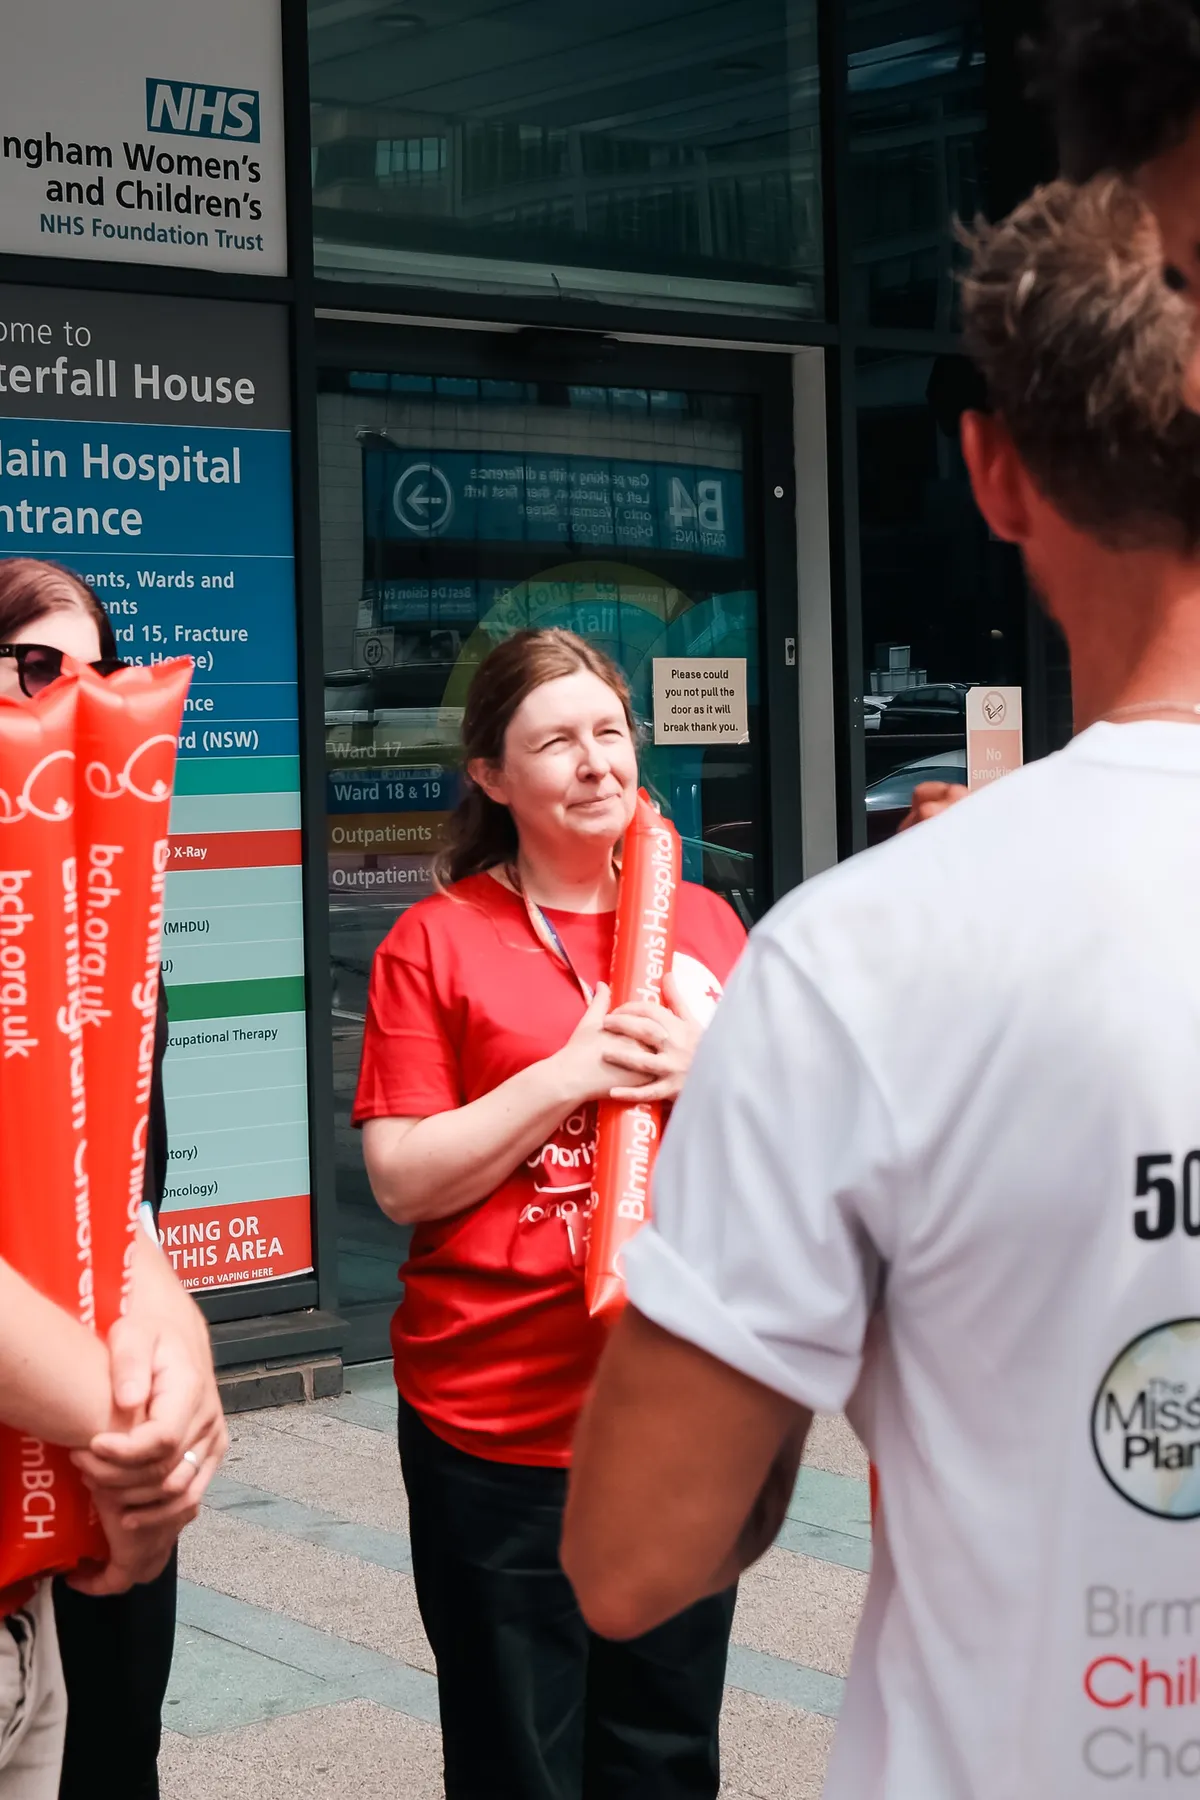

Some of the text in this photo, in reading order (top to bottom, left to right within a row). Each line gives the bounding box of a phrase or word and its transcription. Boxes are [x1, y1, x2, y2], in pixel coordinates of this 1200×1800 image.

[150, 84, 255, 137] NHS
[3, 132, 261, 183] ngham Women's
[46, 176, 262, 220] and Children's
[40, 213, 264, 251] NHS Foundation Trust
[63, 321, 91, 347] to
[134, 364, 255, 405] House
[0, 439, 241, 491] ain Hospital
[0, 499, 143, 536] ntrance
[137, 570, 194, 588] Wards
[201, 571, 234, 588] and
[142, 625, 167, 644] 15,
[175, 625, 248, 642] Fracture
[671, 669, 729, 679] Please could
[665, 687, 735, 698] you not pull the
[671, 704, 731, 714] door as it will
[663, 722, 739, 733] break thank you.
[203, 730, 259, 751] (NSW)
[332, 741, 402, 759] Ward 17
[986, 747, 1002, 761] No
[334, 782, 441, 801] Ward 18 & 19
[331, 824, 432, 847] Outpatients
[174, 846, 207, 860] X-Ray
[332, 866, 432, 889] Outpatients
[642, 827, 676, 933] Hospital
[164, 919, 210, 935] (MHDU)
[232, 1028, 278, 1041] Therapy
[228, 1215, 260, 1238] OR
[168, 1236, 284, 1271] THIS AREA
[202, 1275, 215, 1285] OR
[217, 1271, 249, 1283] VAPING
[251, 1267, 274, 1278] HERE
